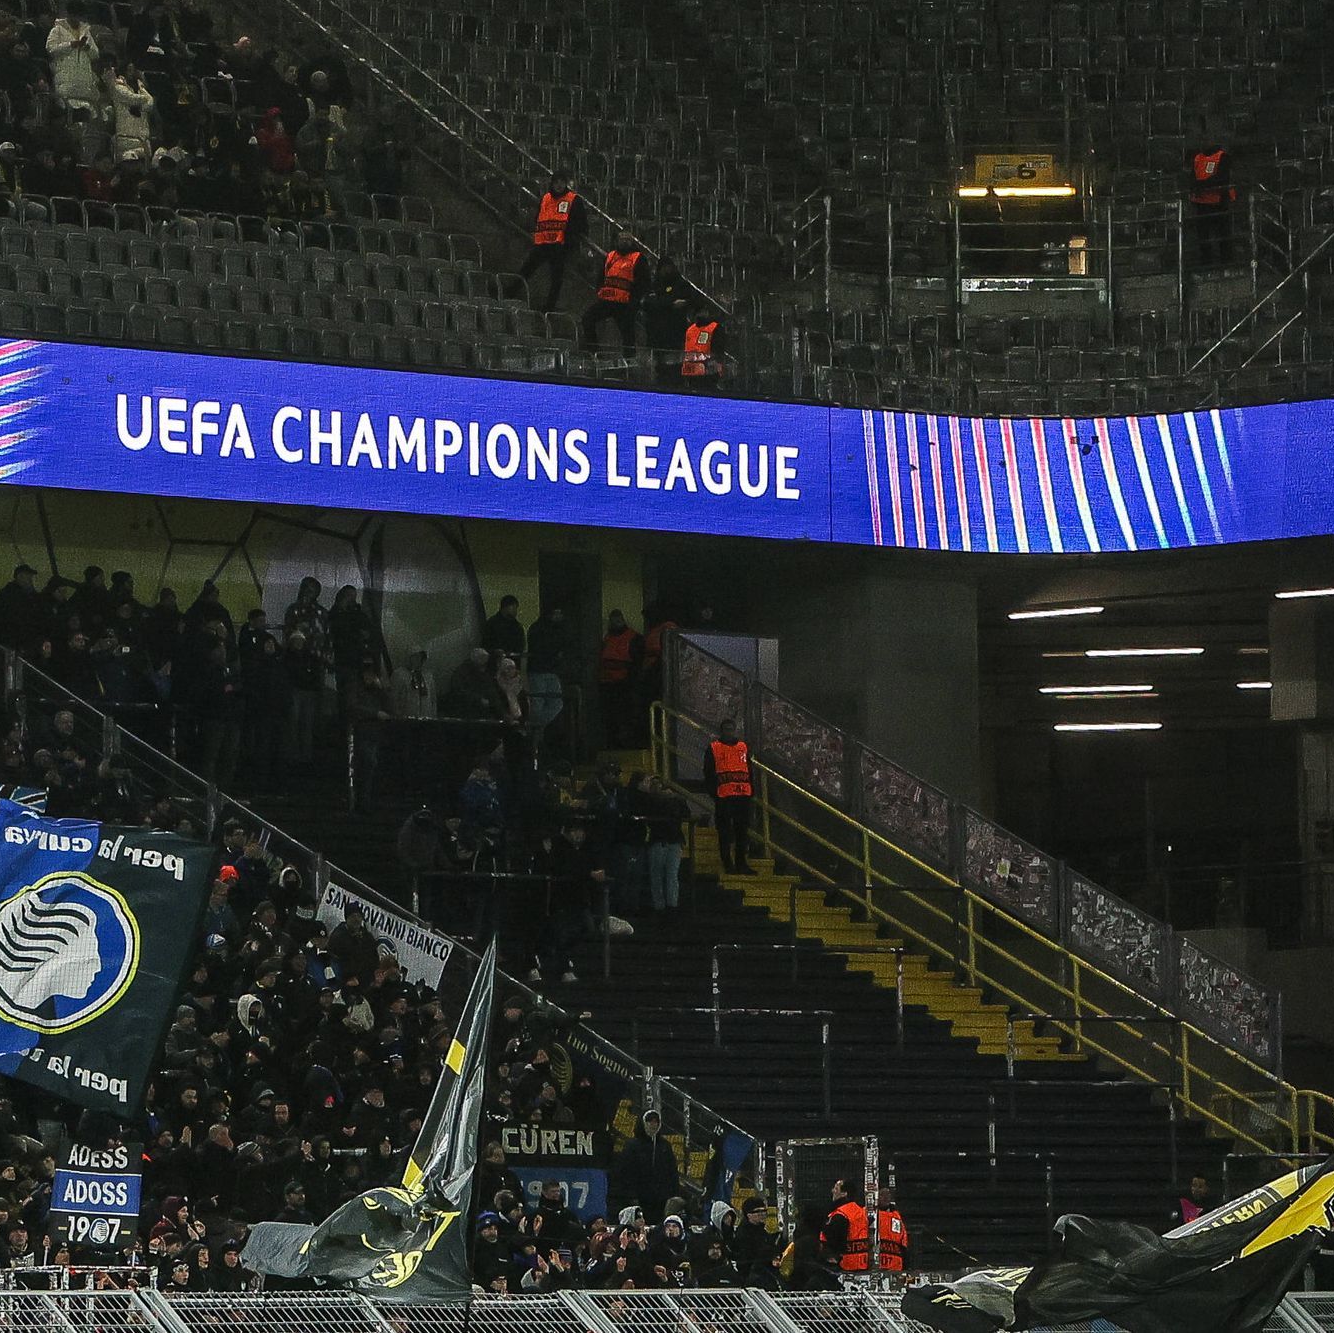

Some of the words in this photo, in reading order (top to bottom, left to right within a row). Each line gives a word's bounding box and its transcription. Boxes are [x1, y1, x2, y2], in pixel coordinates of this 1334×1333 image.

[117, 394, 256, 459] UEFA
[272, 406, 591, 485] CHAMPIONS
[607, 433, 801, 500] LEAGUE
[406, 928, 450, 961] BIANCO
[68, 1143, 128, 1169] ADESS
[501, 1123, 595, 1156] CÜREN
[63, 1178, 128, 1207] ADOSS
